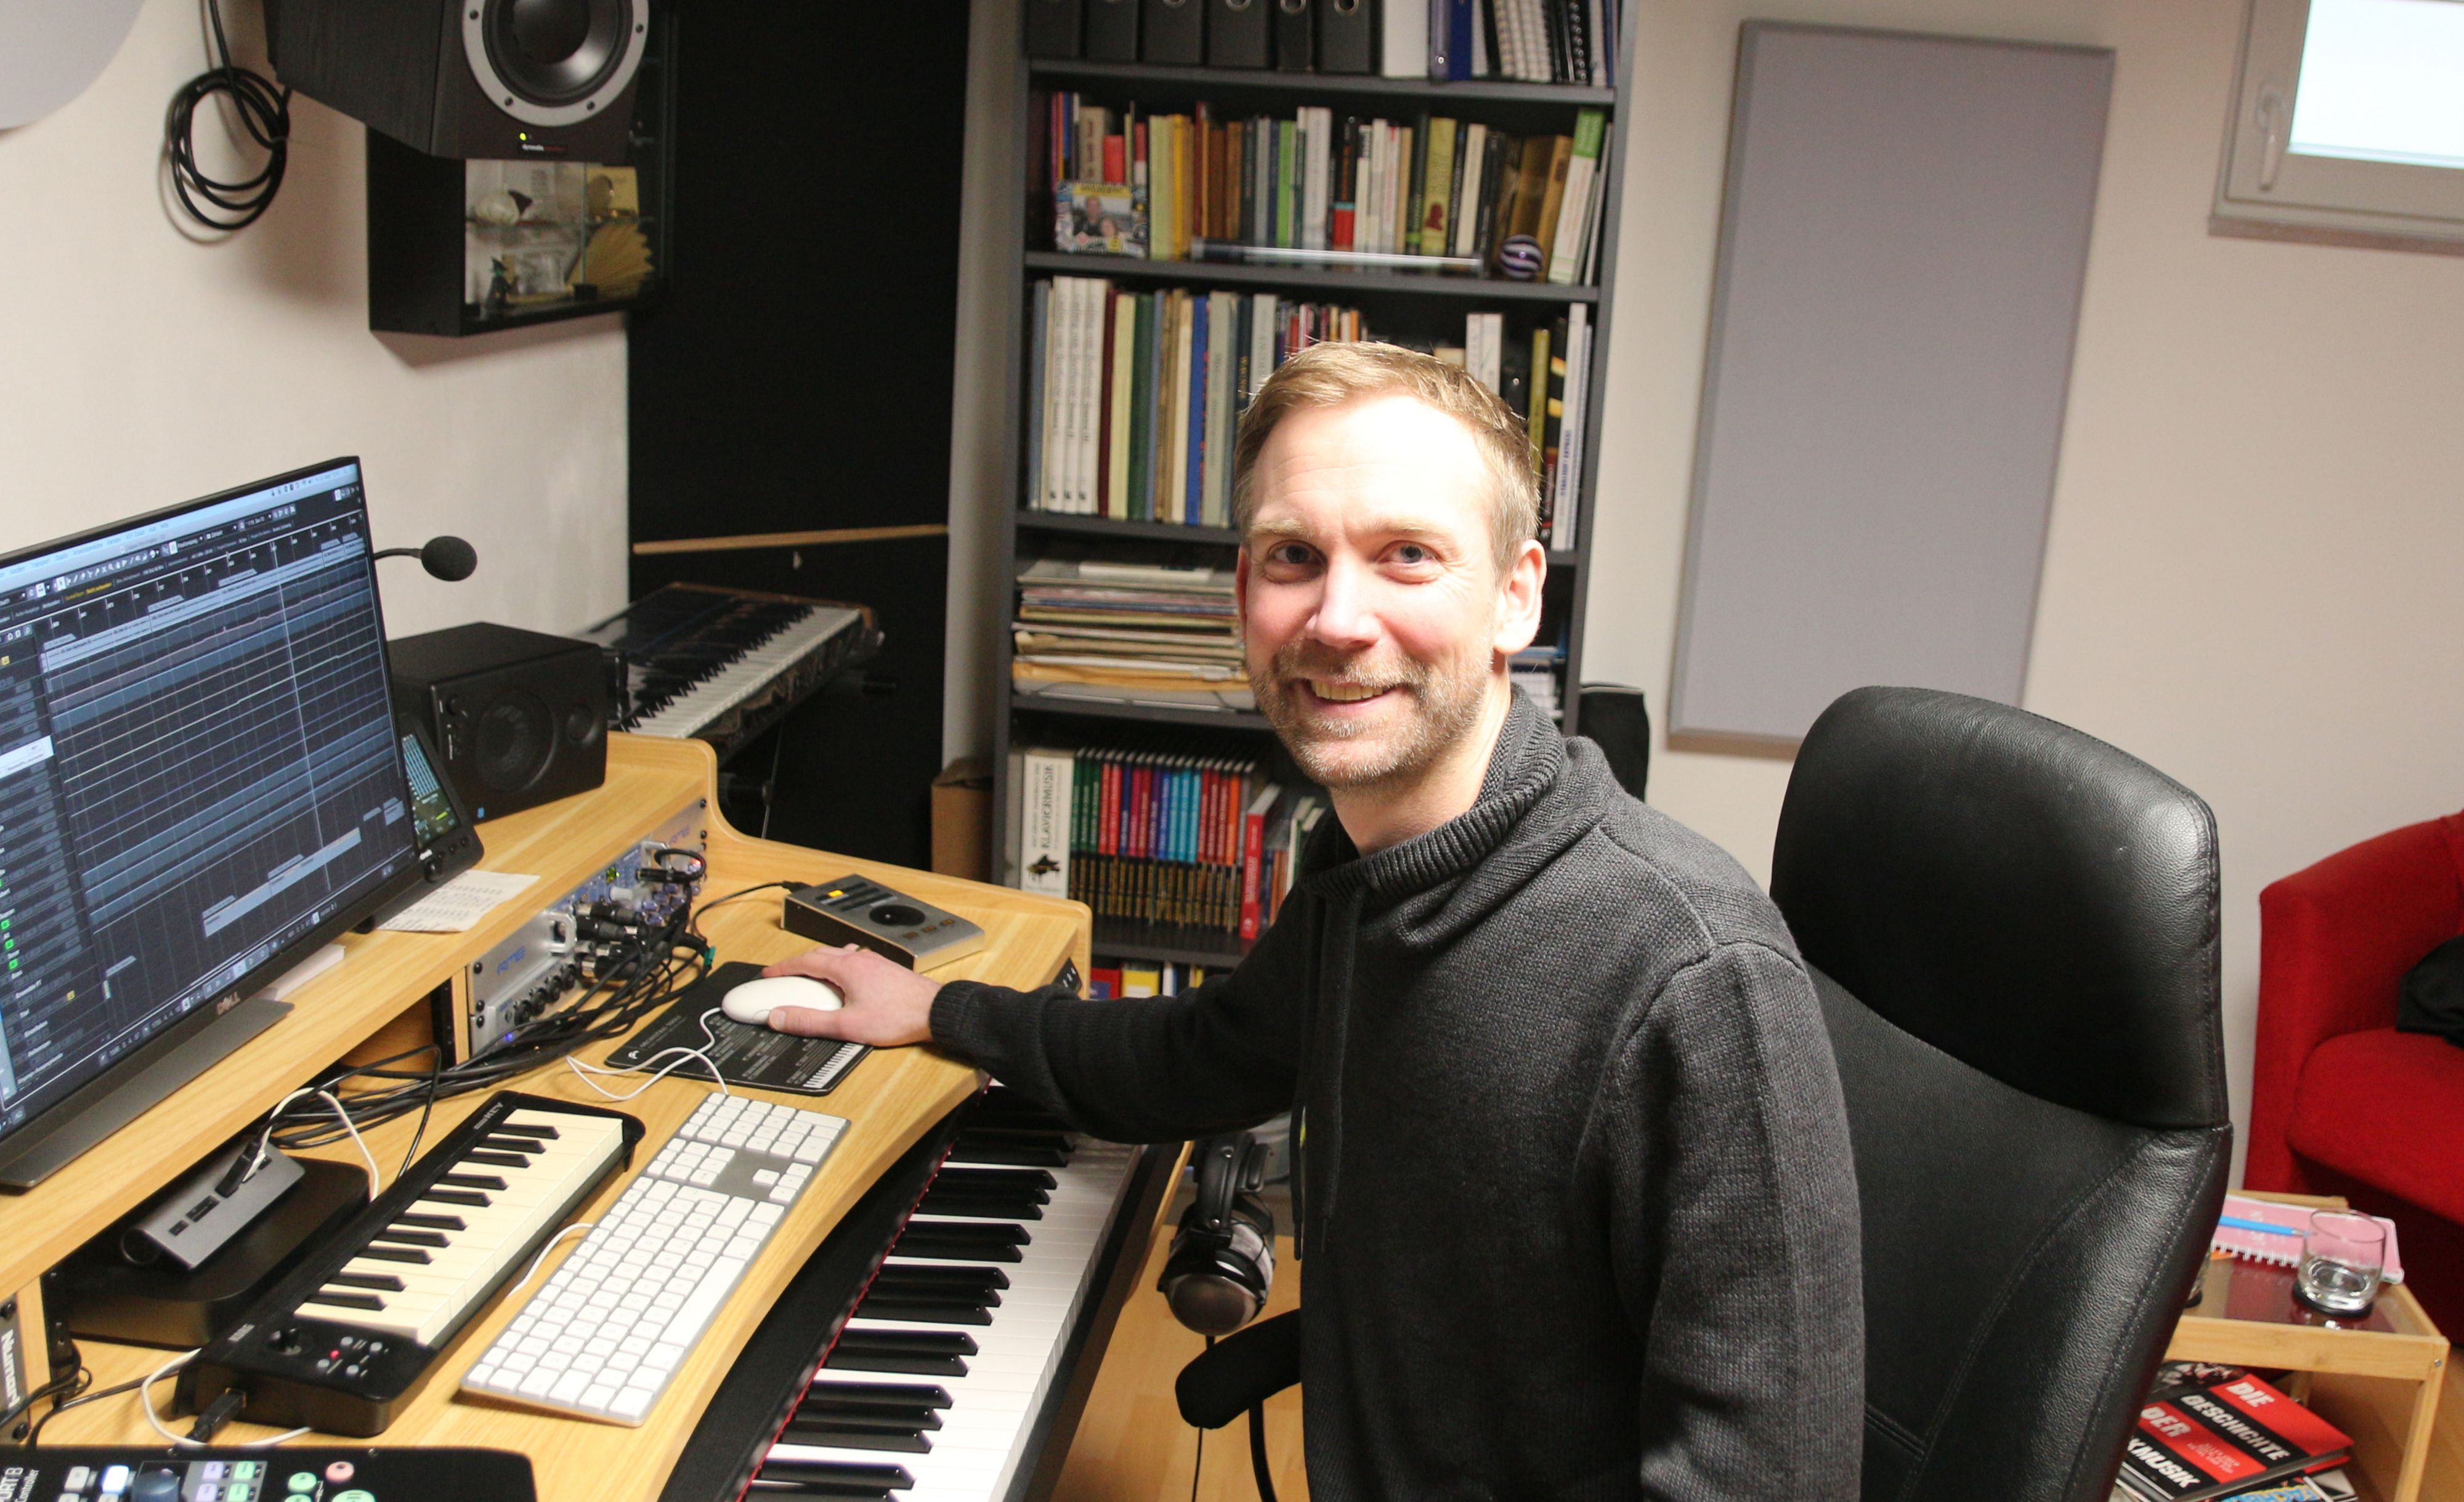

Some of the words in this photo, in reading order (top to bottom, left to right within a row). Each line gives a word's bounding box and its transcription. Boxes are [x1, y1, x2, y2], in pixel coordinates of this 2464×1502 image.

[217, 991, 241, 1016] DELL
[2226, 1381, 2275, 1408] DIE
[2141, 1406, 2191, 1437] DER
[2180, 1394, 2290, 1461] GESCHICHTE
